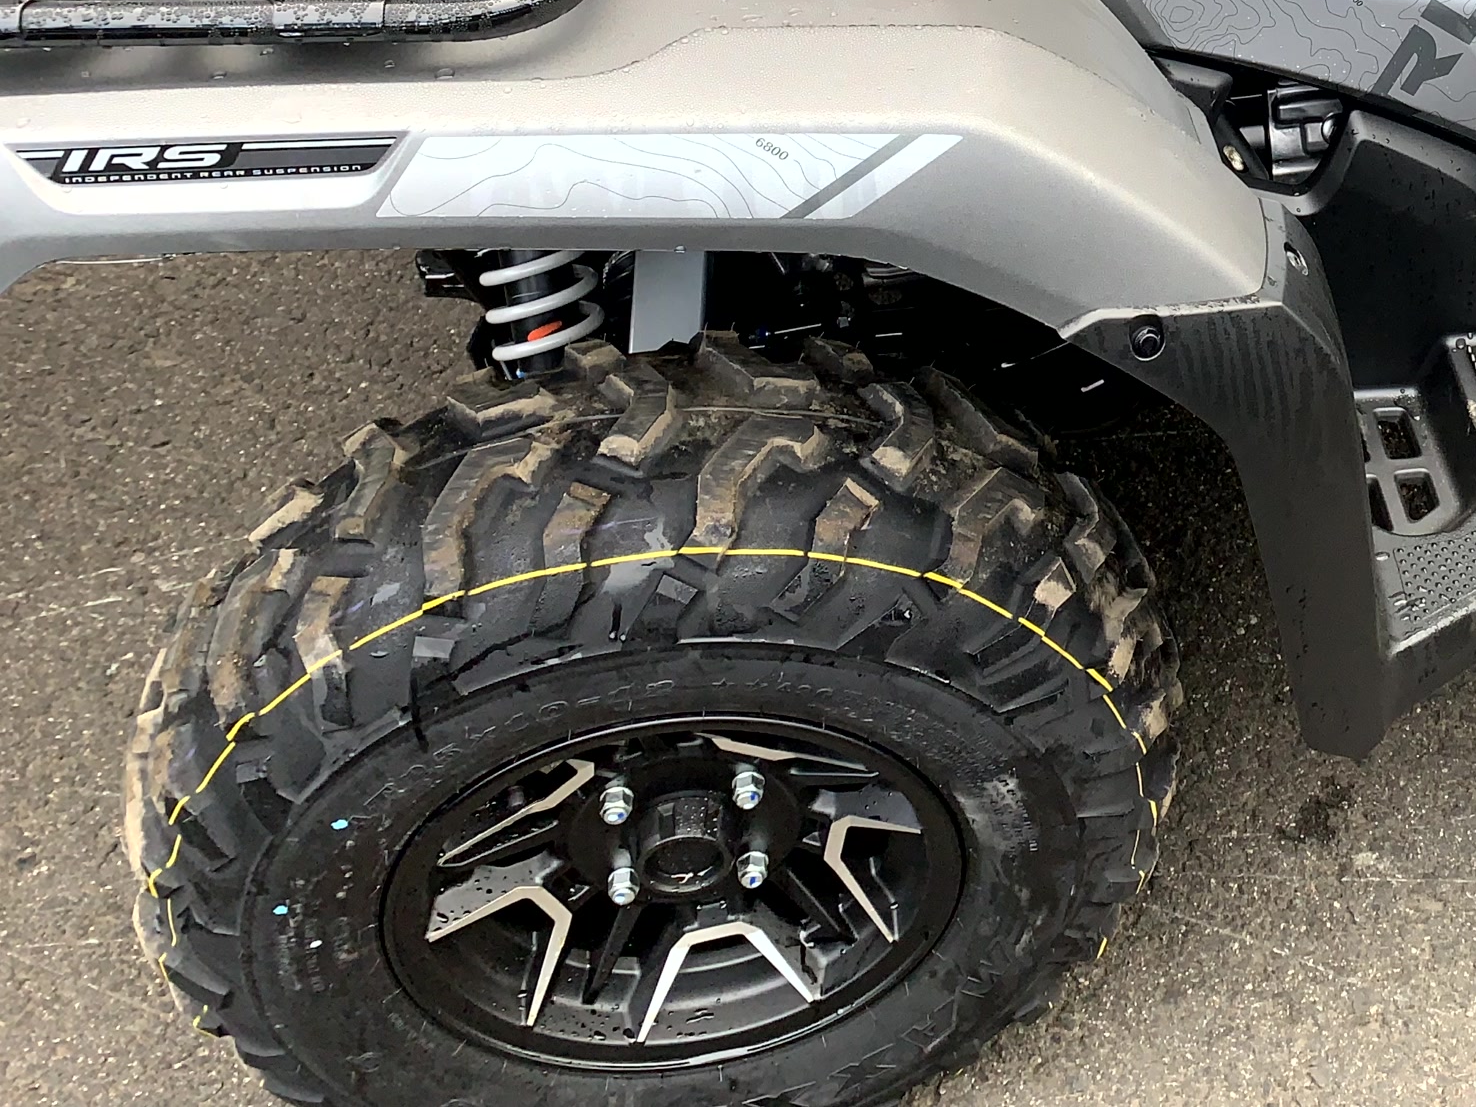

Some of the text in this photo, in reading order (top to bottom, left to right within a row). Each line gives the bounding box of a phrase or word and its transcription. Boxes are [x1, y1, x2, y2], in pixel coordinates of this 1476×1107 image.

[61, 143, 228, 172] IRS
[755, 137, 789, 160] 6800
[65, 164, 362, 184] INDEPENDENT REAR SUSPENSION
